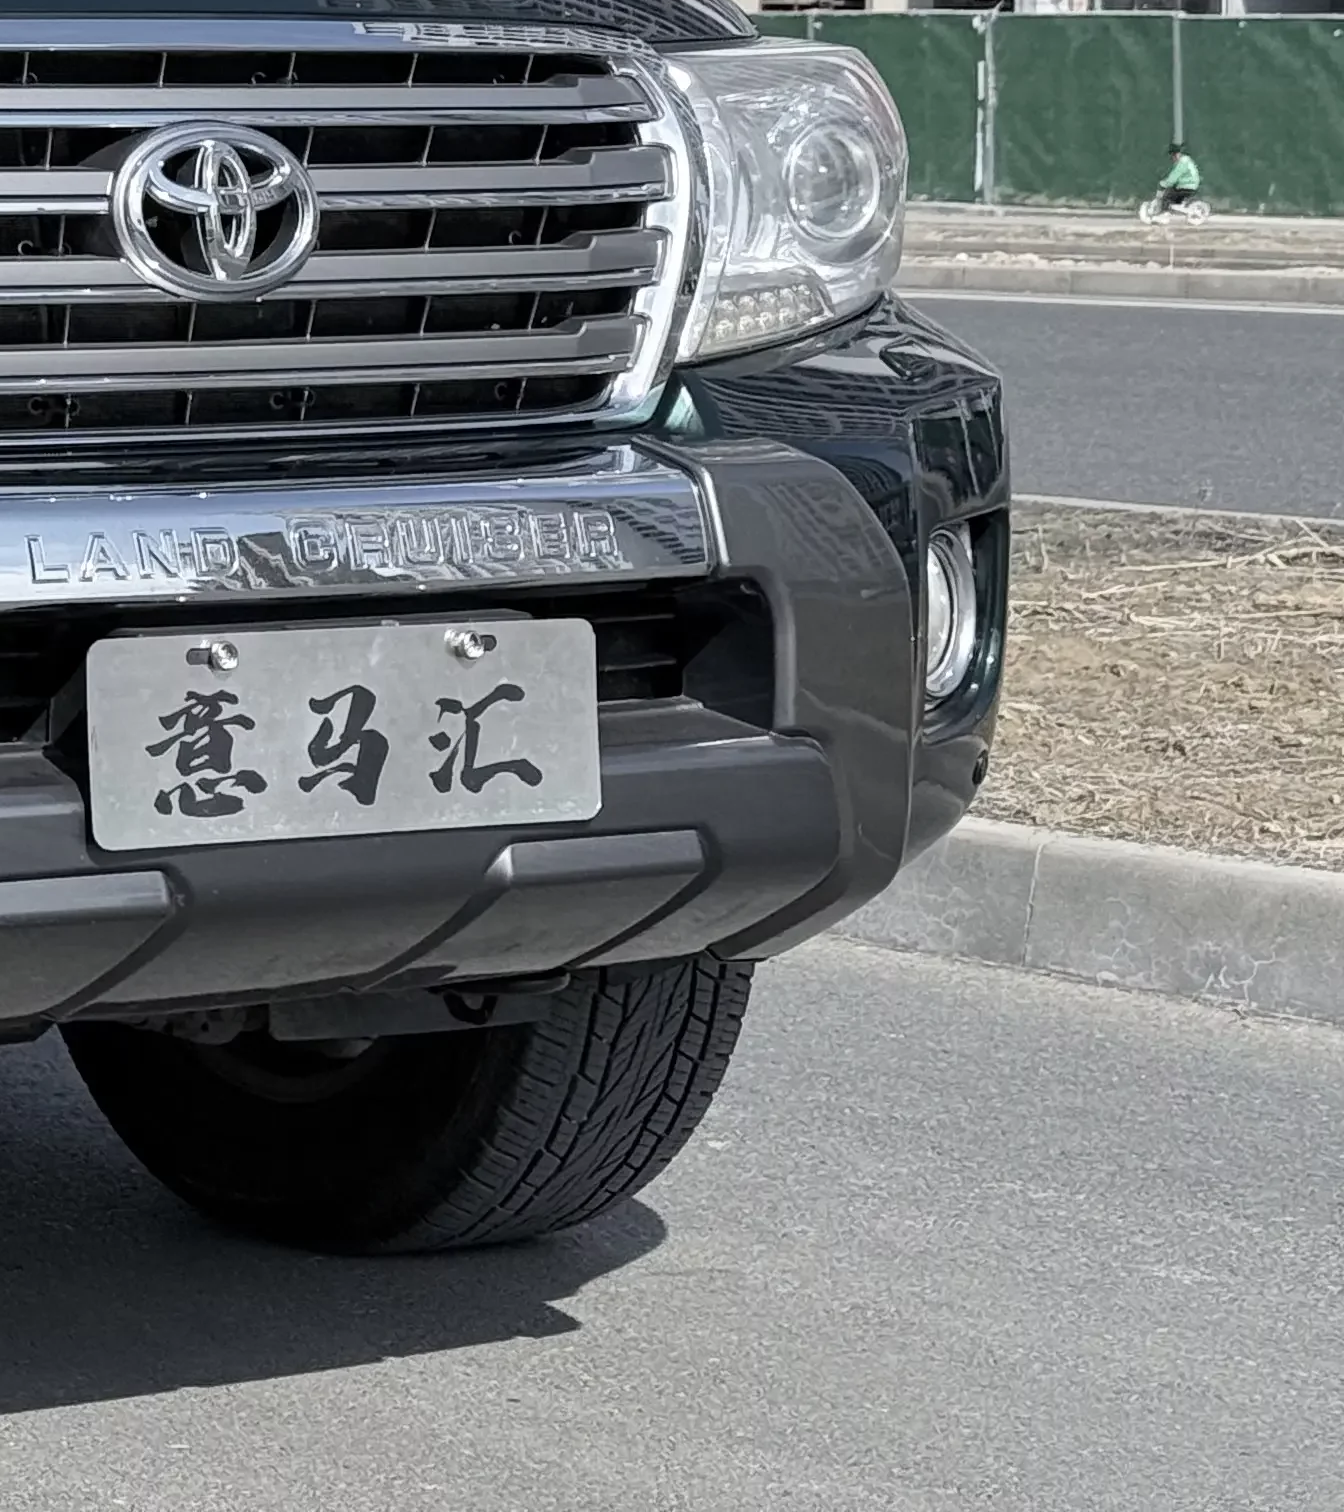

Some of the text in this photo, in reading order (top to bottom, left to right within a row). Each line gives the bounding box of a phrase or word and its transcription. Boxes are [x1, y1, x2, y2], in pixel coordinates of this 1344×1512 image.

[24, 510, 624, 585] LAND CRUISER
[144, 684, 543, 817] 意马汇
